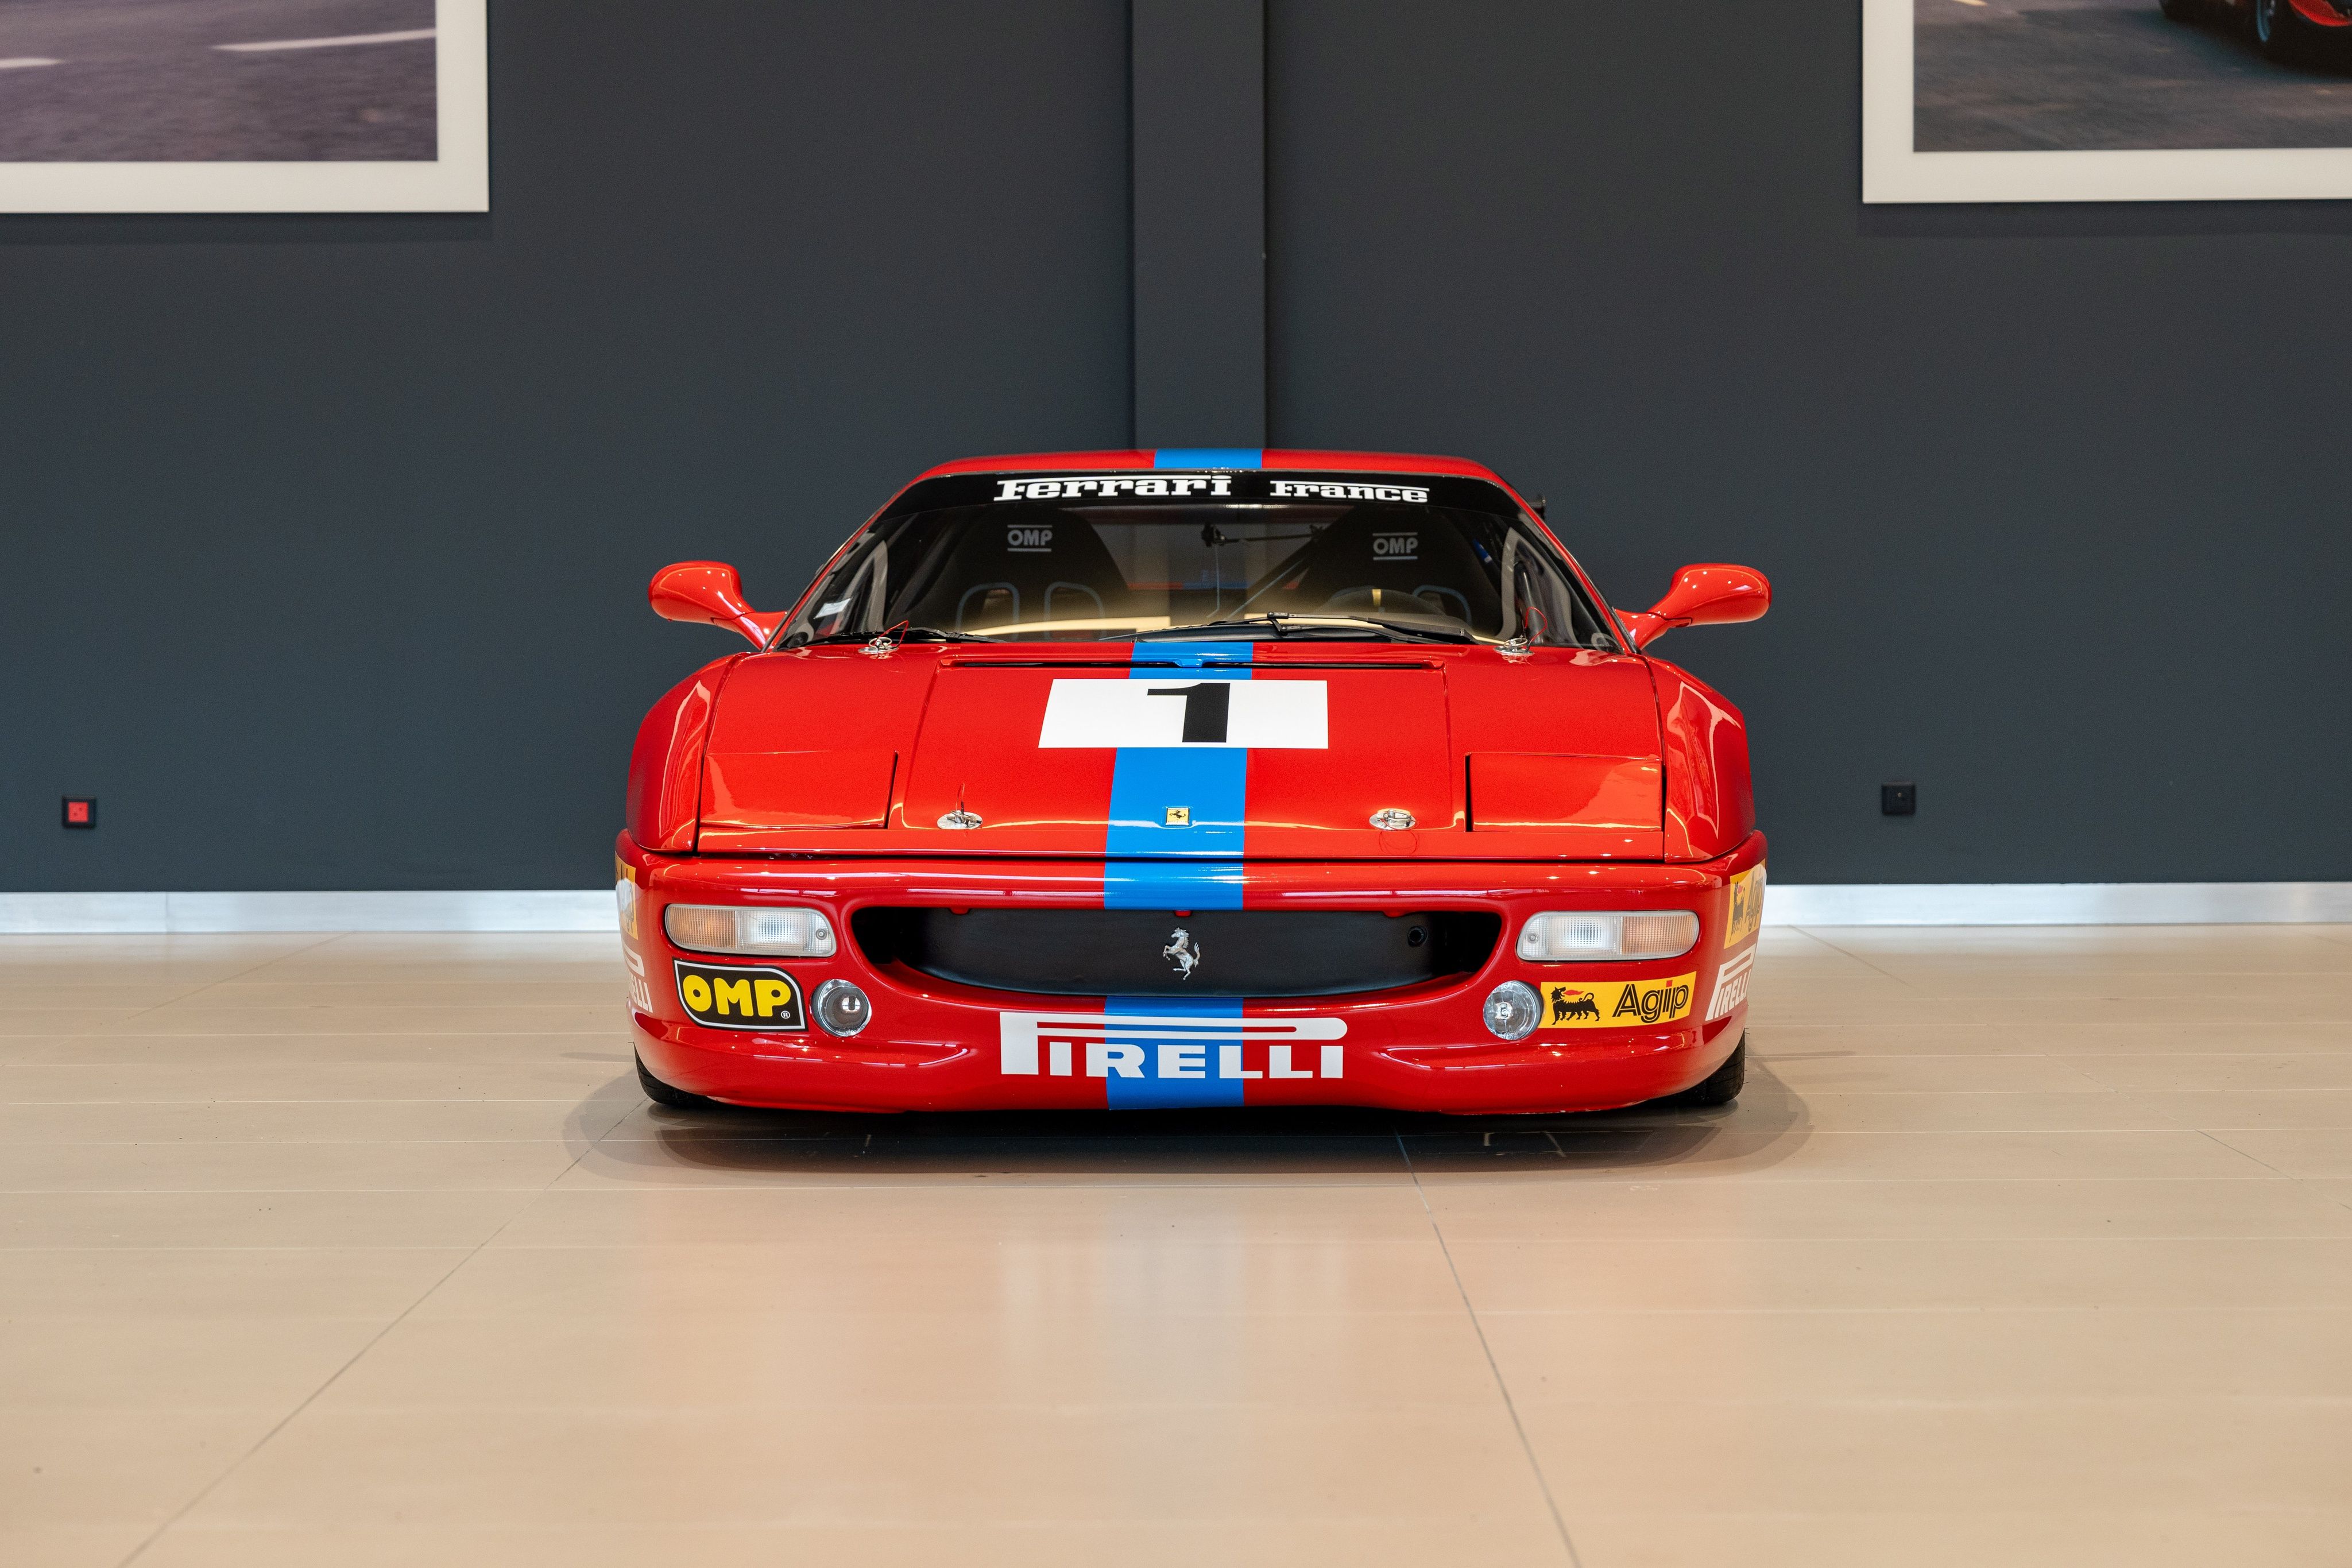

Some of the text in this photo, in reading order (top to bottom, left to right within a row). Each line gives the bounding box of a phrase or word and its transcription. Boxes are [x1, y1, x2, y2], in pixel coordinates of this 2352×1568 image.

[993, 475, 1430, 502] Ferrari France
[1007, 529, 1053, 546] OMP
[1373, 537, 1418, 555] OMP
[1147, 682, 1231, 743] 1
[683, 974, 791, 1017] OMP
[1612, 979, 1689, 1024] Agip
[1705, 943, 1757, 1021] PIRELLI
[1000, 1012, 1348, 1079] PIRELLI
